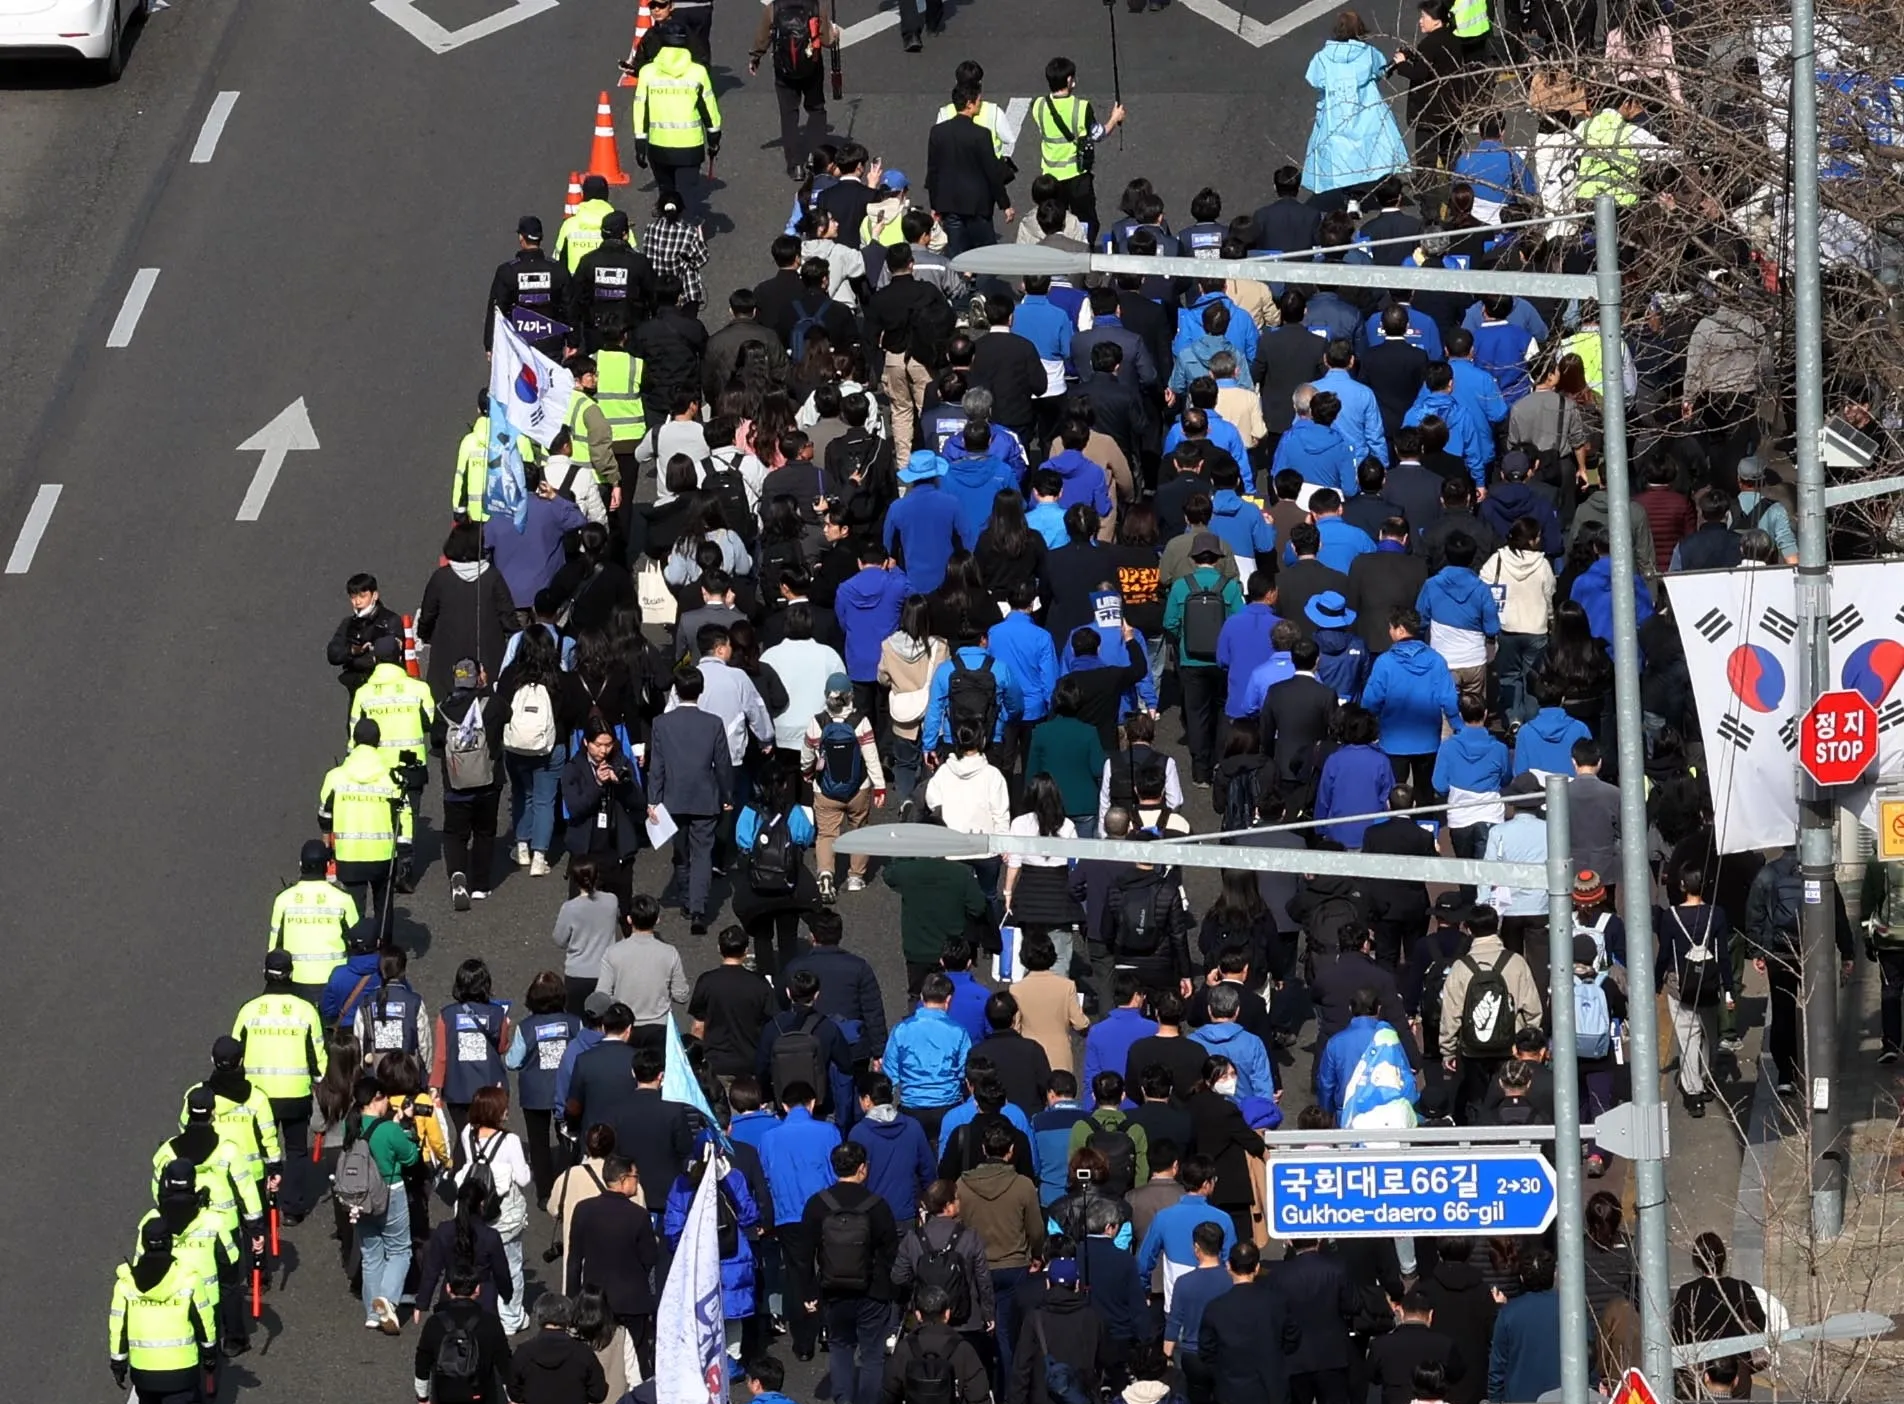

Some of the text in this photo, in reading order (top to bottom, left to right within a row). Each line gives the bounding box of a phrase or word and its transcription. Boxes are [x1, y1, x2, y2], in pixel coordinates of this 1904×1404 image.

[572, 240, 601, 249] POLI
[1119, 567, 1160, 583] OPEN
[368, 706, 413, 715] POLICE
[1815, 709, 1864, 740] 정지
[1815, 740, 1863, 764] STOP
[341, 793, 386, 802] POLICE
[218, 1115, 249, 1123] LICE
[1280, 1163, 1479, 1201] 국회대로66길
[1281, 1201, 1504, 1225] Gukhoe-daero 66-gil
[131, 1298, 180, 1307] POLICE
